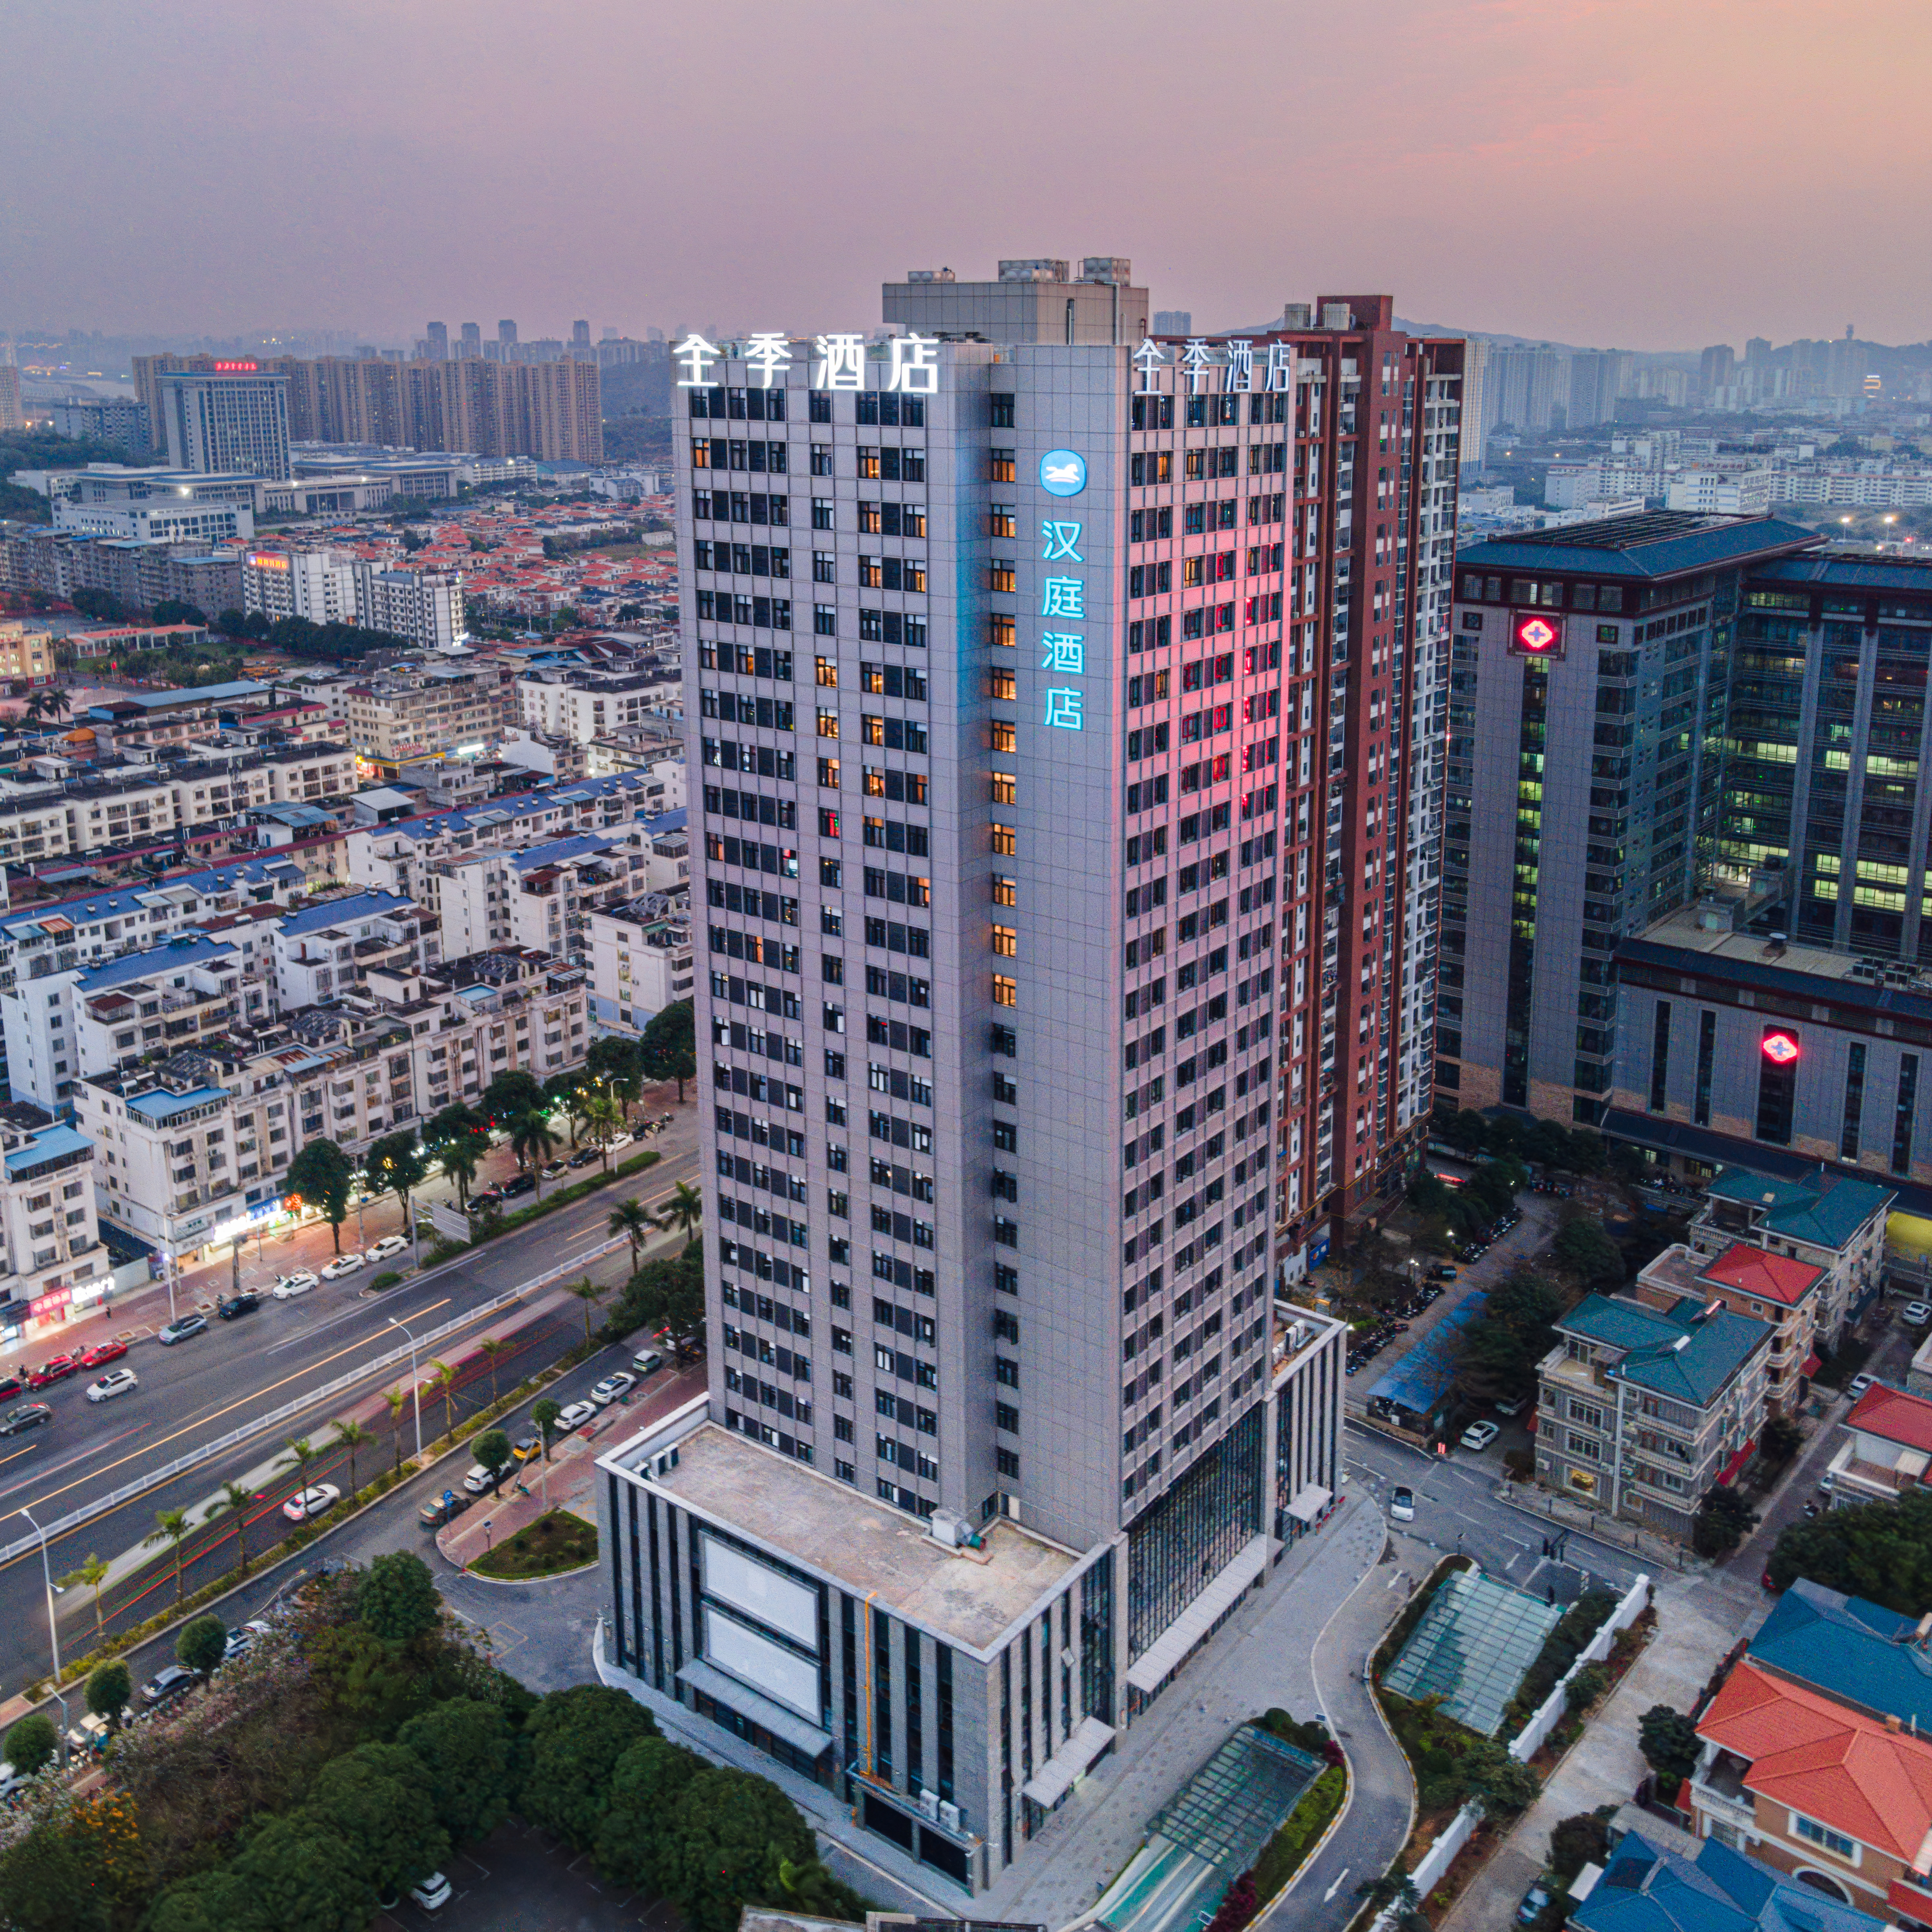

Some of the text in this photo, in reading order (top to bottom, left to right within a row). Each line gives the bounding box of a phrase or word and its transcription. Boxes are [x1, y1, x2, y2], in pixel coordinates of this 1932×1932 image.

[673, 332, 939, 394] 全季酒店
[1133, 338, 1290, 395] 全季酒店
[1042, 520, 1084, 730] 汉庭酒店
